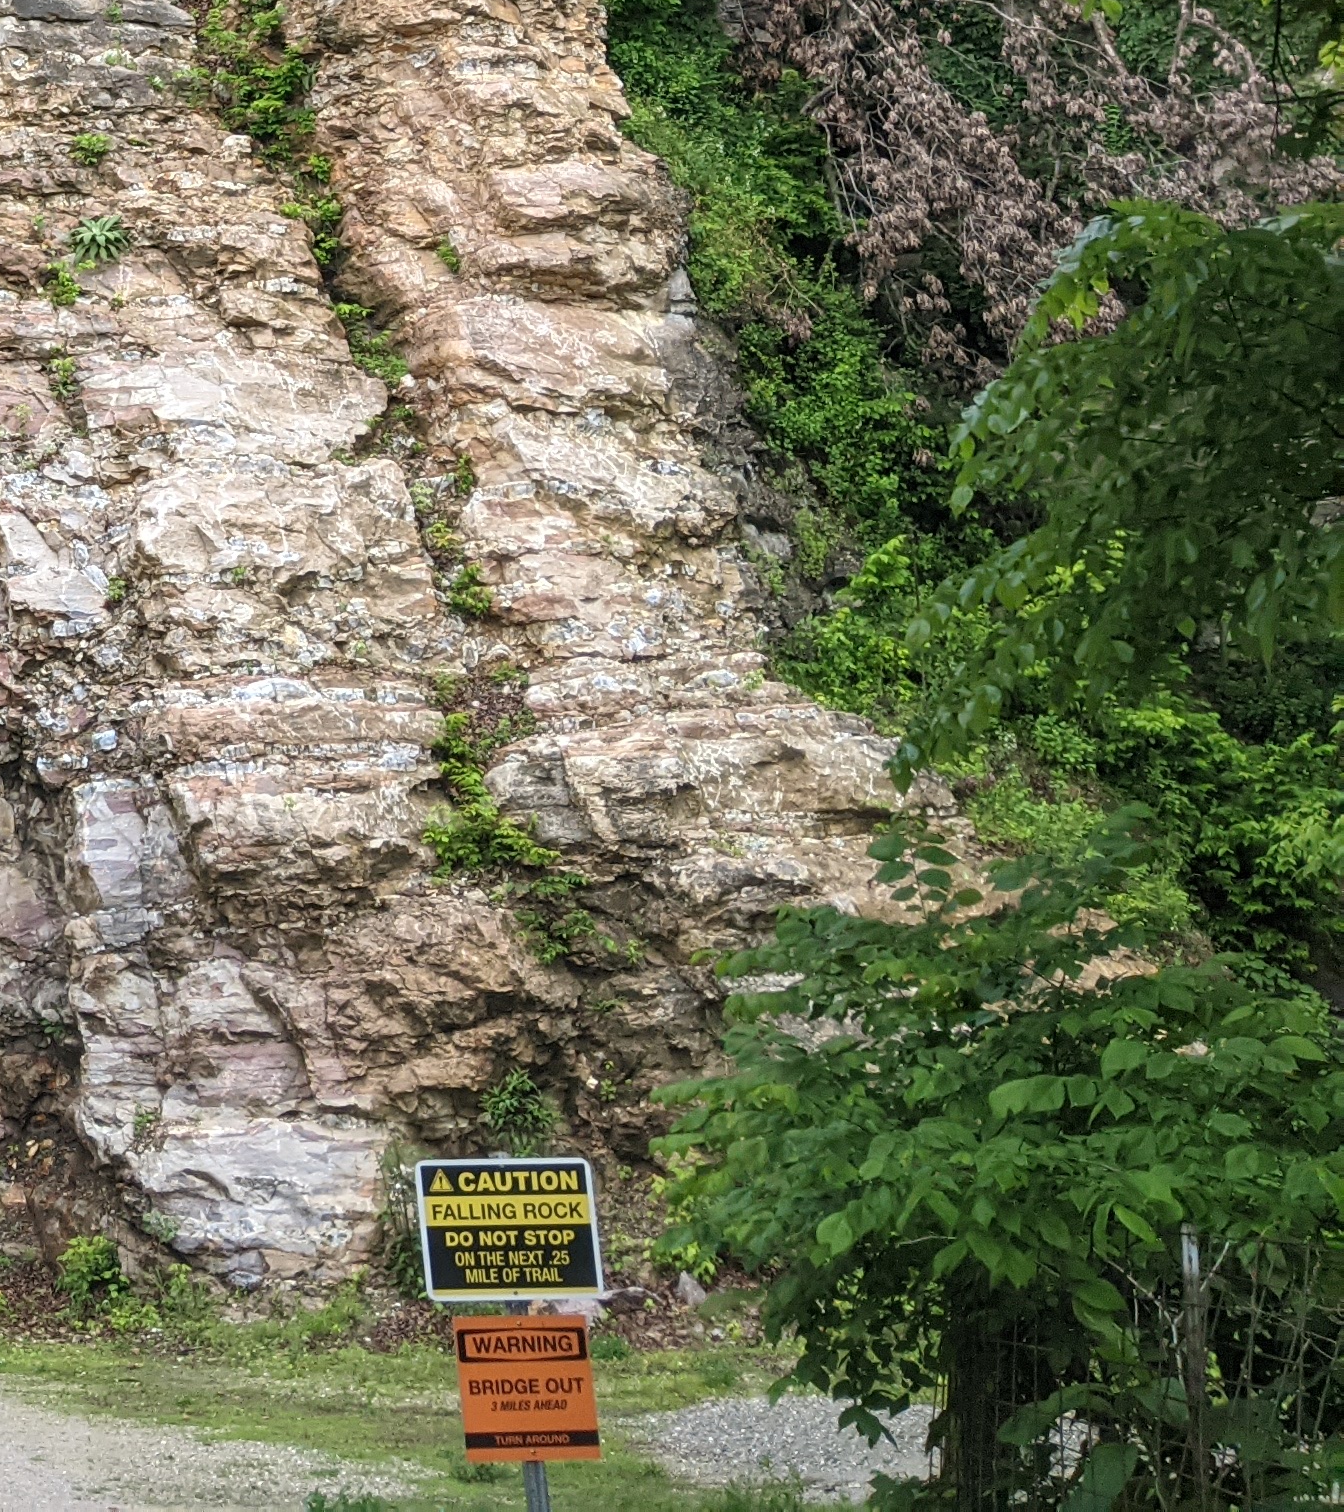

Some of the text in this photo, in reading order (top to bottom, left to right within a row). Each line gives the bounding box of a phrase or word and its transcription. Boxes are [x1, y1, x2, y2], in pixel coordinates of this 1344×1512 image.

[458, 1171, 579, 1192] CAUTION
[432, 1202, 583, 1220] FALLING ROCK
[445, 1230, 575, 1247] DO NOT STOP
[455, 1250, 569, 1266] ON THE NEXT .25
[465, 1268, 563, 1283] MILE OF TRAIL
[472, 1335, 573, 1354] WARNING
[468, 1377, 584, 1395] BRIDGE OUT
[491, 1399, 567, 1411] 3 MILES AHEAD
[495, 1435, 570, 1445] TURN AROUND
